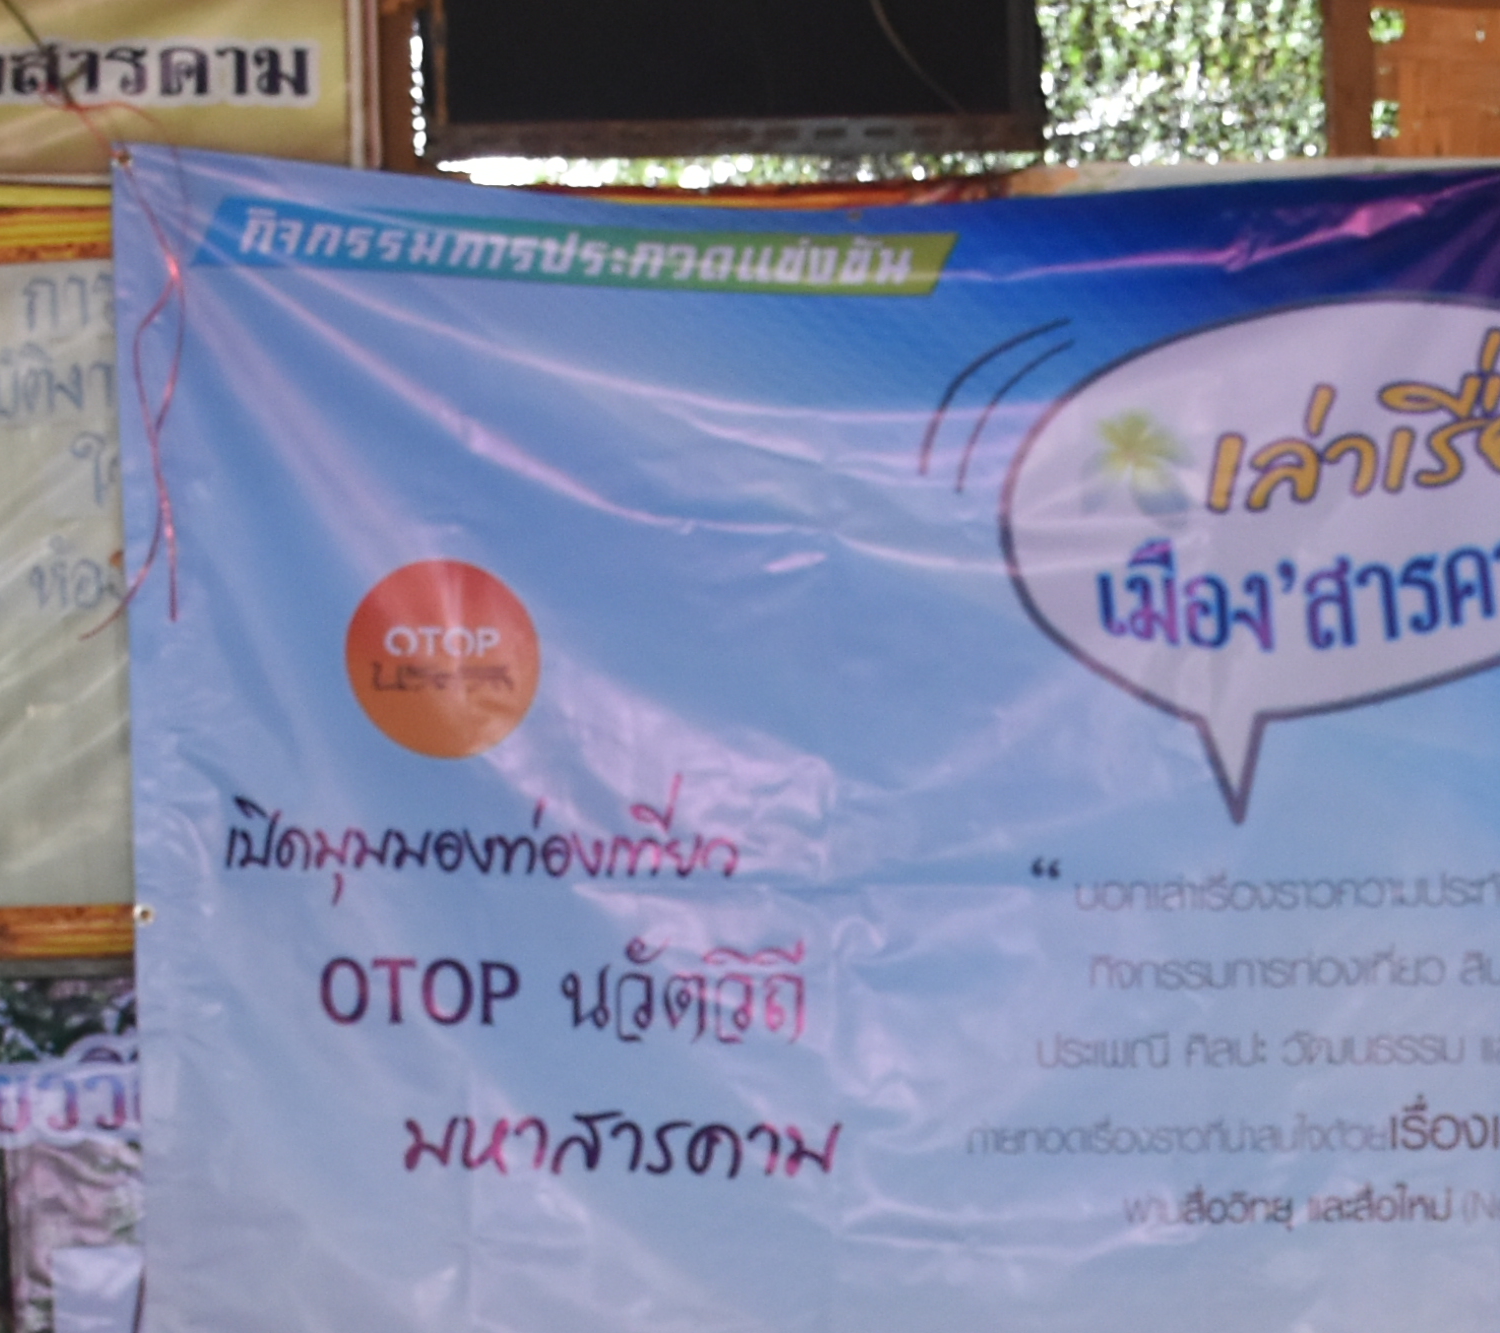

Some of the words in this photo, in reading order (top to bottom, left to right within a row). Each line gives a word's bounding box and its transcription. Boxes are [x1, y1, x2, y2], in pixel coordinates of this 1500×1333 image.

[238, 206, 914, 287] กิจกรรมการประกวดแข่งขัน
[384, 624, 501, 657] OTOP
[225, 774, 741, 906] เปิดมุมมองท่องเที่ยว
[319, 957, 521, 1026] OTOP
[560, 937, 807, 1044] นวัตวิถี
[1036, 1032, 1170, 1068] ประเพณี
[1185, 1030, 1267, 1067] ศิลปะ
[1281, 1029, 1466, 1066] วัฒนธรรม
[403, 1109, 844, 1180] มหาสารคาม
